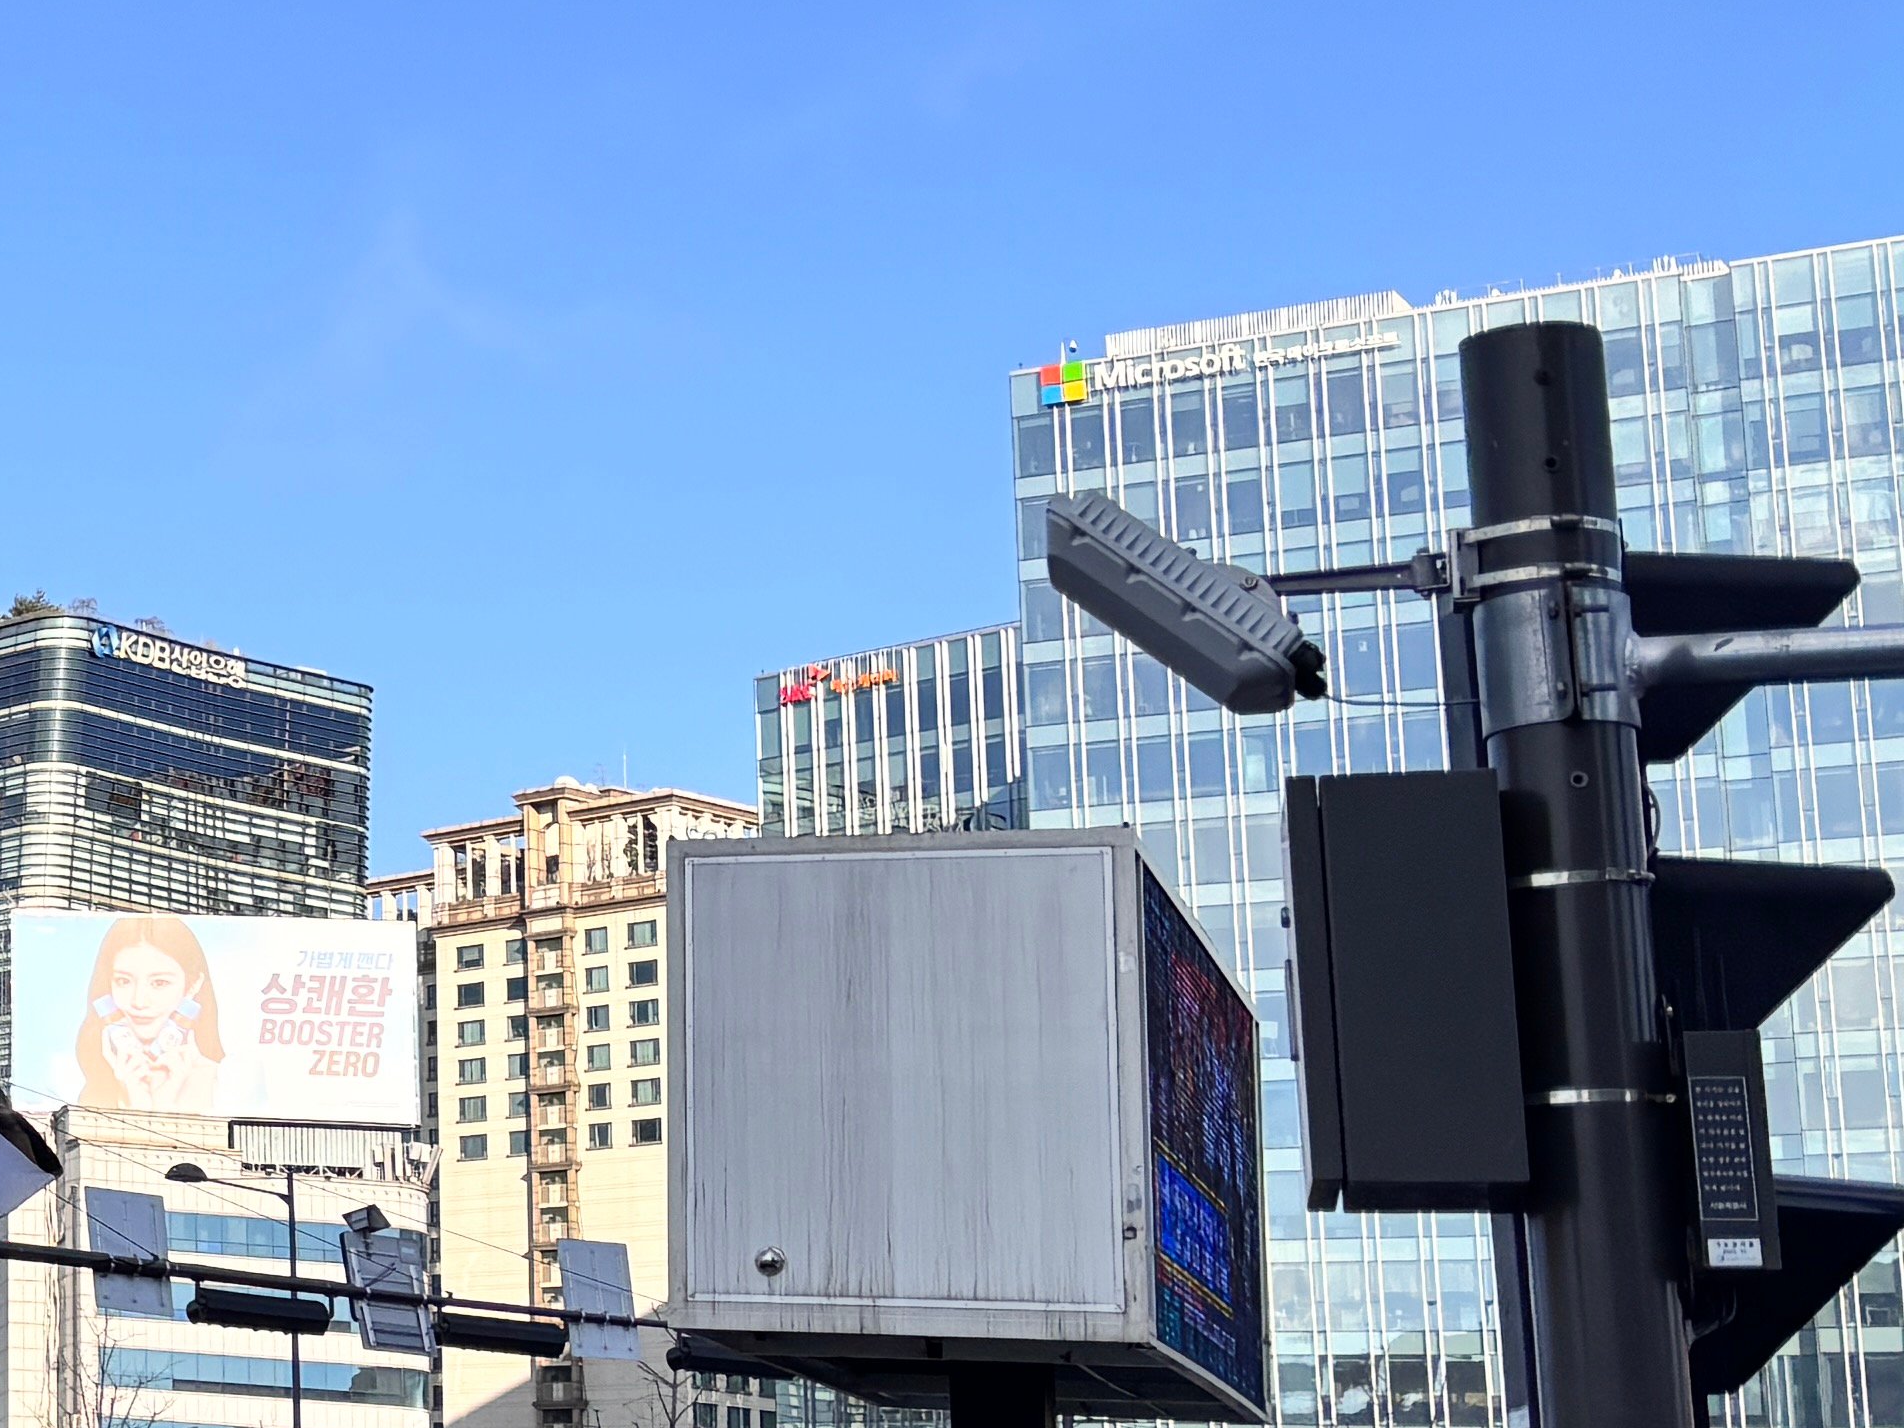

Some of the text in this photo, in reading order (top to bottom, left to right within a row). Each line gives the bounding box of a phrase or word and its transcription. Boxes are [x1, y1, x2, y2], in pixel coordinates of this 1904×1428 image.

[1094, 344, 1247, 390] Microsoft
[261, 973, 393, 1018] 상쾌환
[259, 1018, 385, 1048] BOOSTER
[308, 1050, 380, 1078] ZERO
